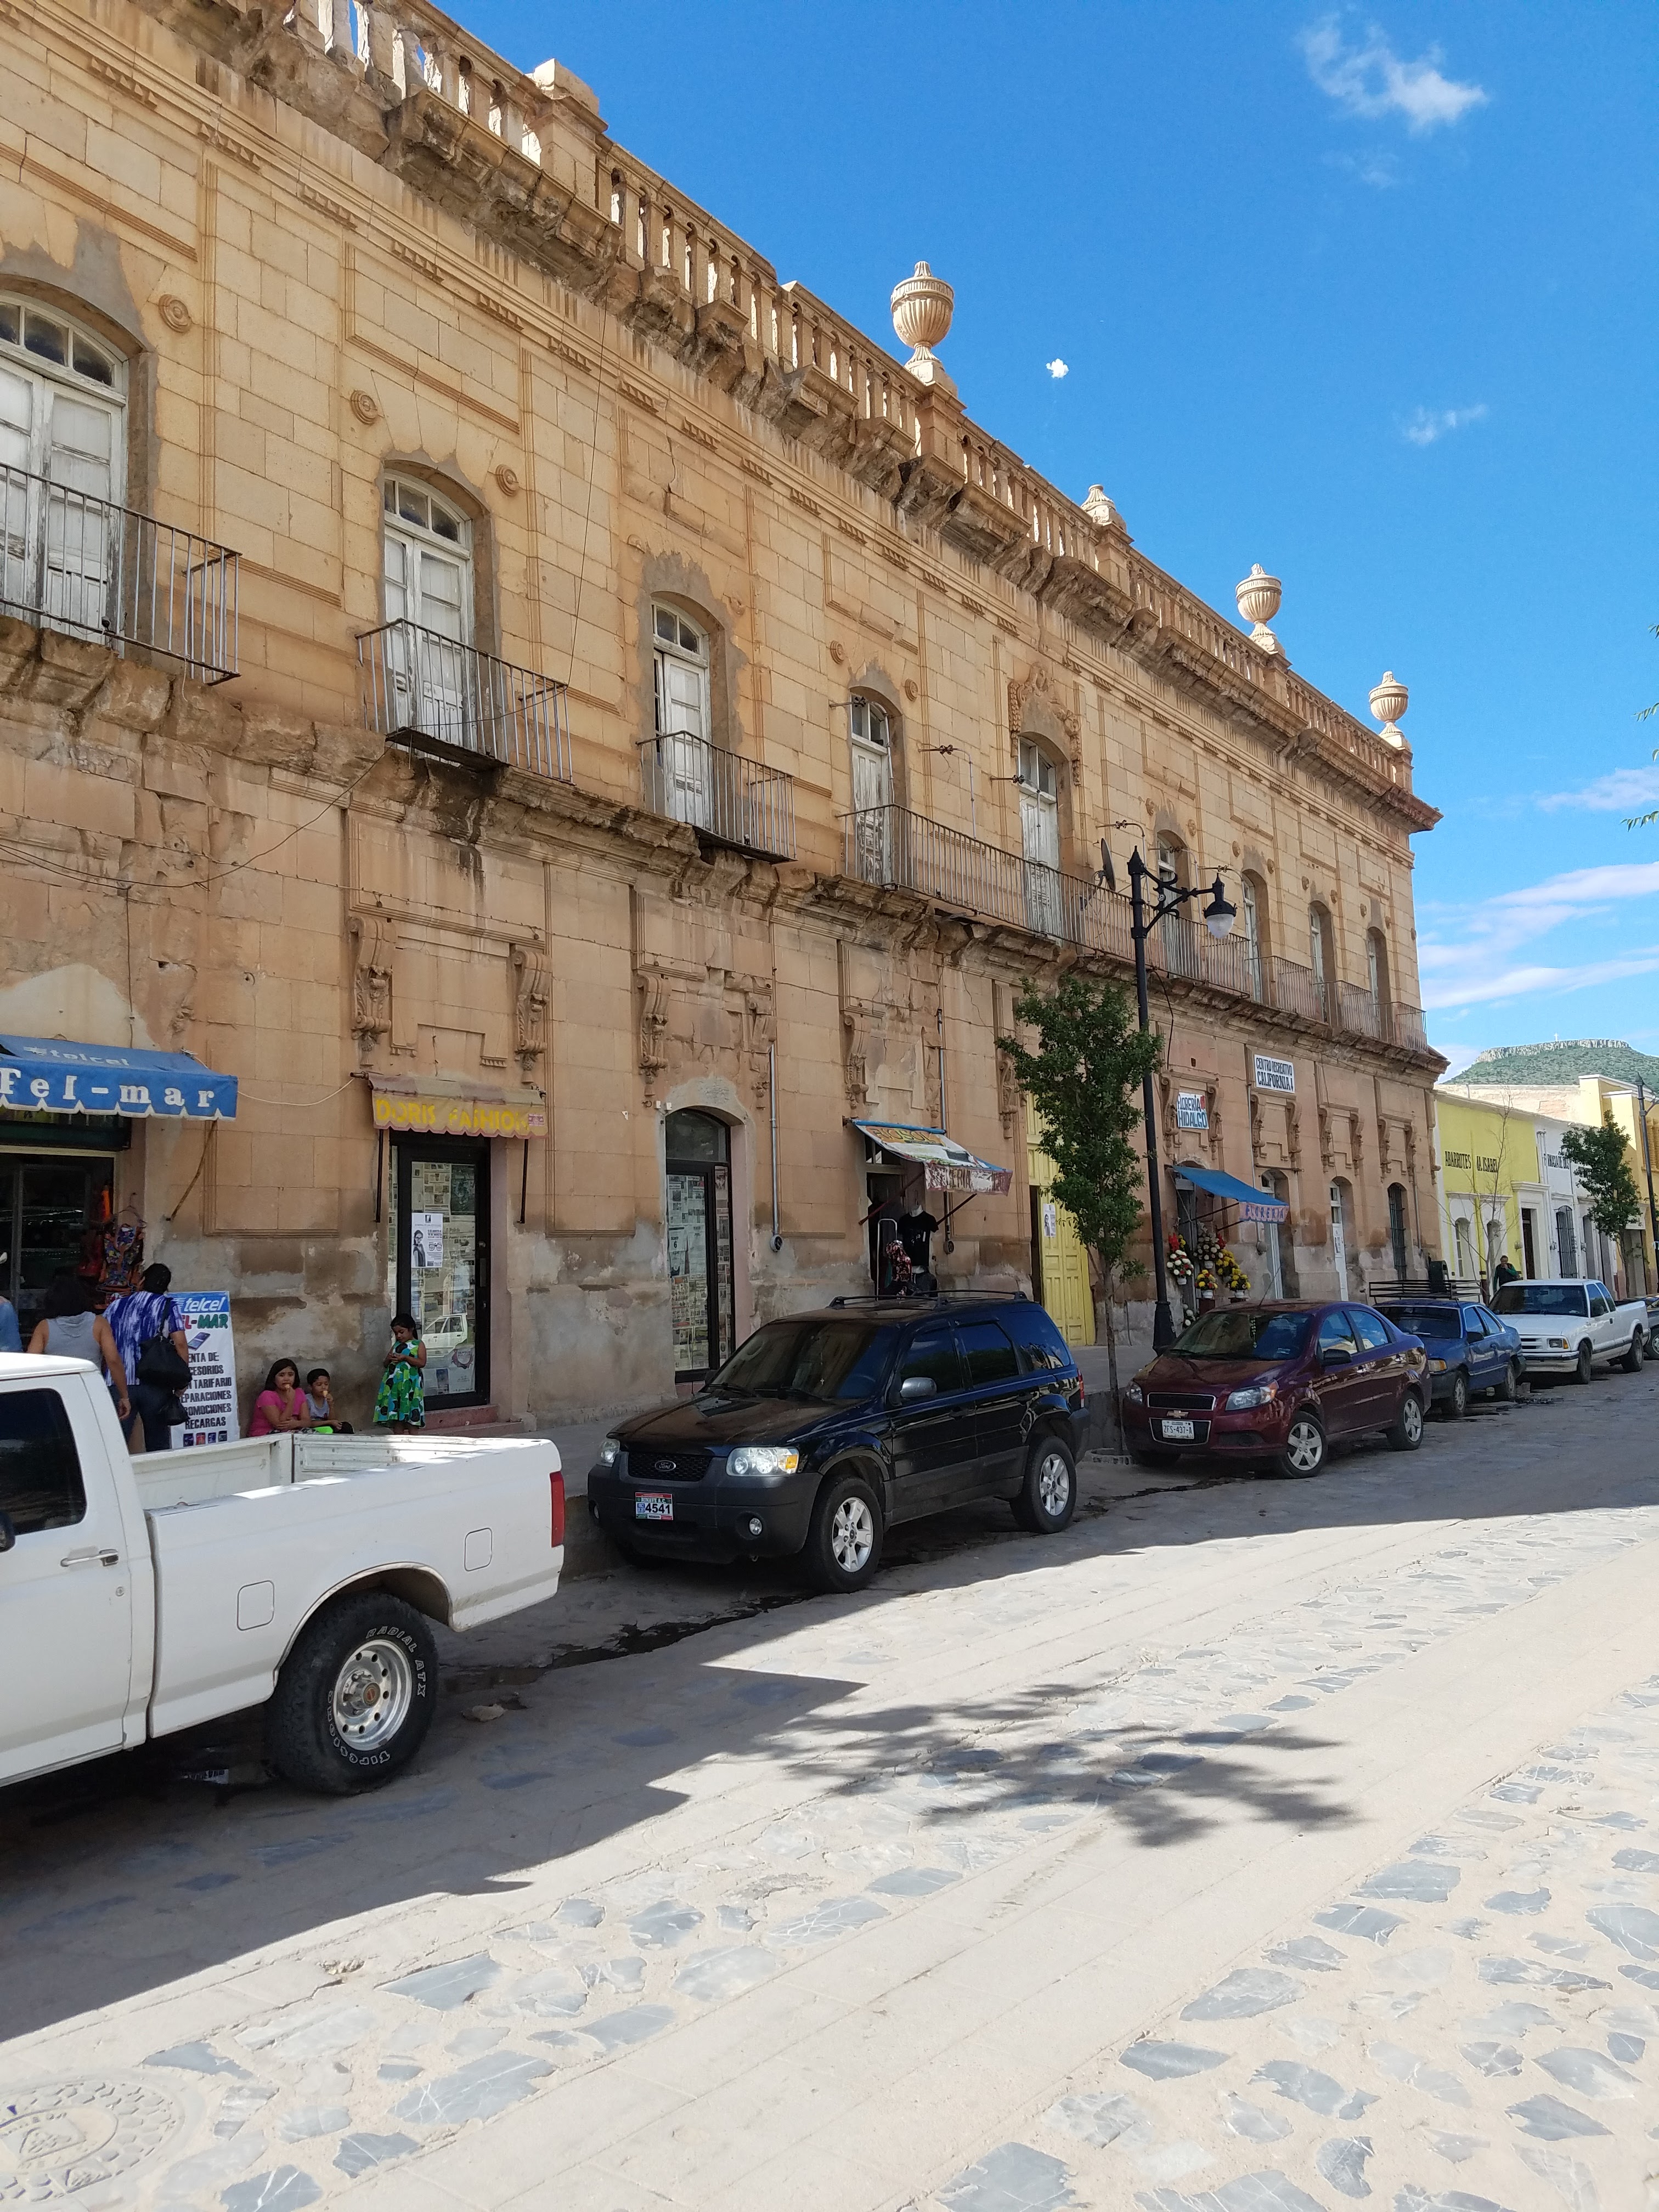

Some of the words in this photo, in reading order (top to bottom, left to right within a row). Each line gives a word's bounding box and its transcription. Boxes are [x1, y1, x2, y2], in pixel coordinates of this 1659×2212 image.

[50, 1049, 129, 1066] telcel
[1256, 1058, 1272, 1071] CENTRO
[1272, 1060, 1293, 1076] RECREATIVO
[1257, 1071, 1291, 1091] CALIFORNIA
[376, 1099, 436, 1124] DORIS
[1178, 1110, 1207, 1128] HIDALGO
[1444, 1150, 1471, 1169] ABARROTES
[1482, 1156, 1499, 1173] ISABEL
[183, 1296, 226, 1312] telcel
[188, 1352, 206, 1363] ENTA
[208, 1352, 219, 1362] DE
[194, 1377, 232, 1389] TARIFARIO
[181, 1390, 232, 1403] EPARACIONES
[185, 1417, 226, 1430] RECARGAS
[1164, 1425, 1193, 1435] ZFS-437-A
[645, 1503, 670, 1514] 4541
[365, 1626, 418, 1653] RADIAL
[415, 1659, 427, 1698] ATX
